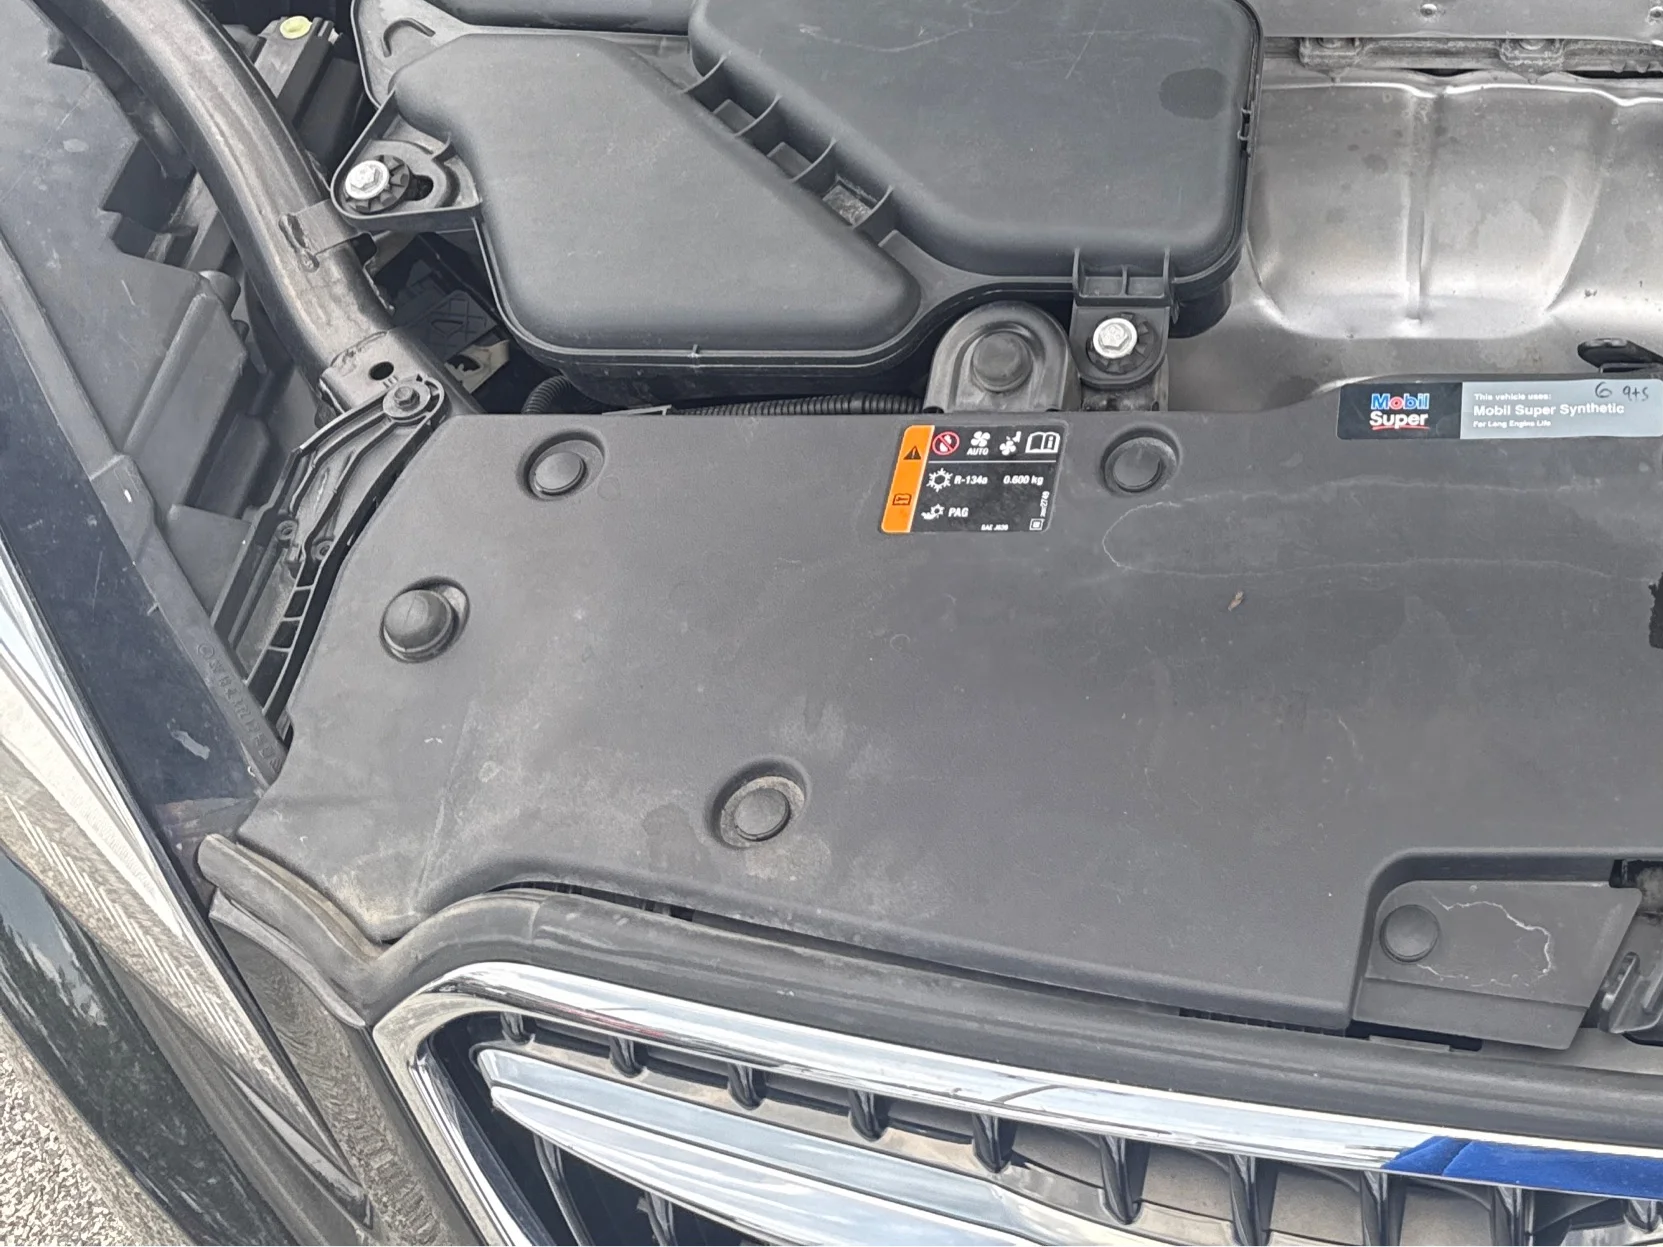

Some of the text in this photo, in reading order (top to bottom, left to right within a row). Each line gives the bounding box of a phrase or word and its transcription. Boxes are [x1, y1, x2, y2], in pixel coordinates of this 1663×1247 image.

[1595, 381, 1612, 398] 6
[1371, 393, 1430, 410] Mobil
[1473, 402, 1624, 418] Mobil Super Synthetic
[1369, 411, 1428, 429] Super
[1473, 420, 1486, 428] For
[1509, 420, 1535, 428] Engine
[966, 447, 989, 456] AUTO
[954, 475, 1044, 486] R-134a 0.600 kg
[948, 507, 969, 517] PAG
